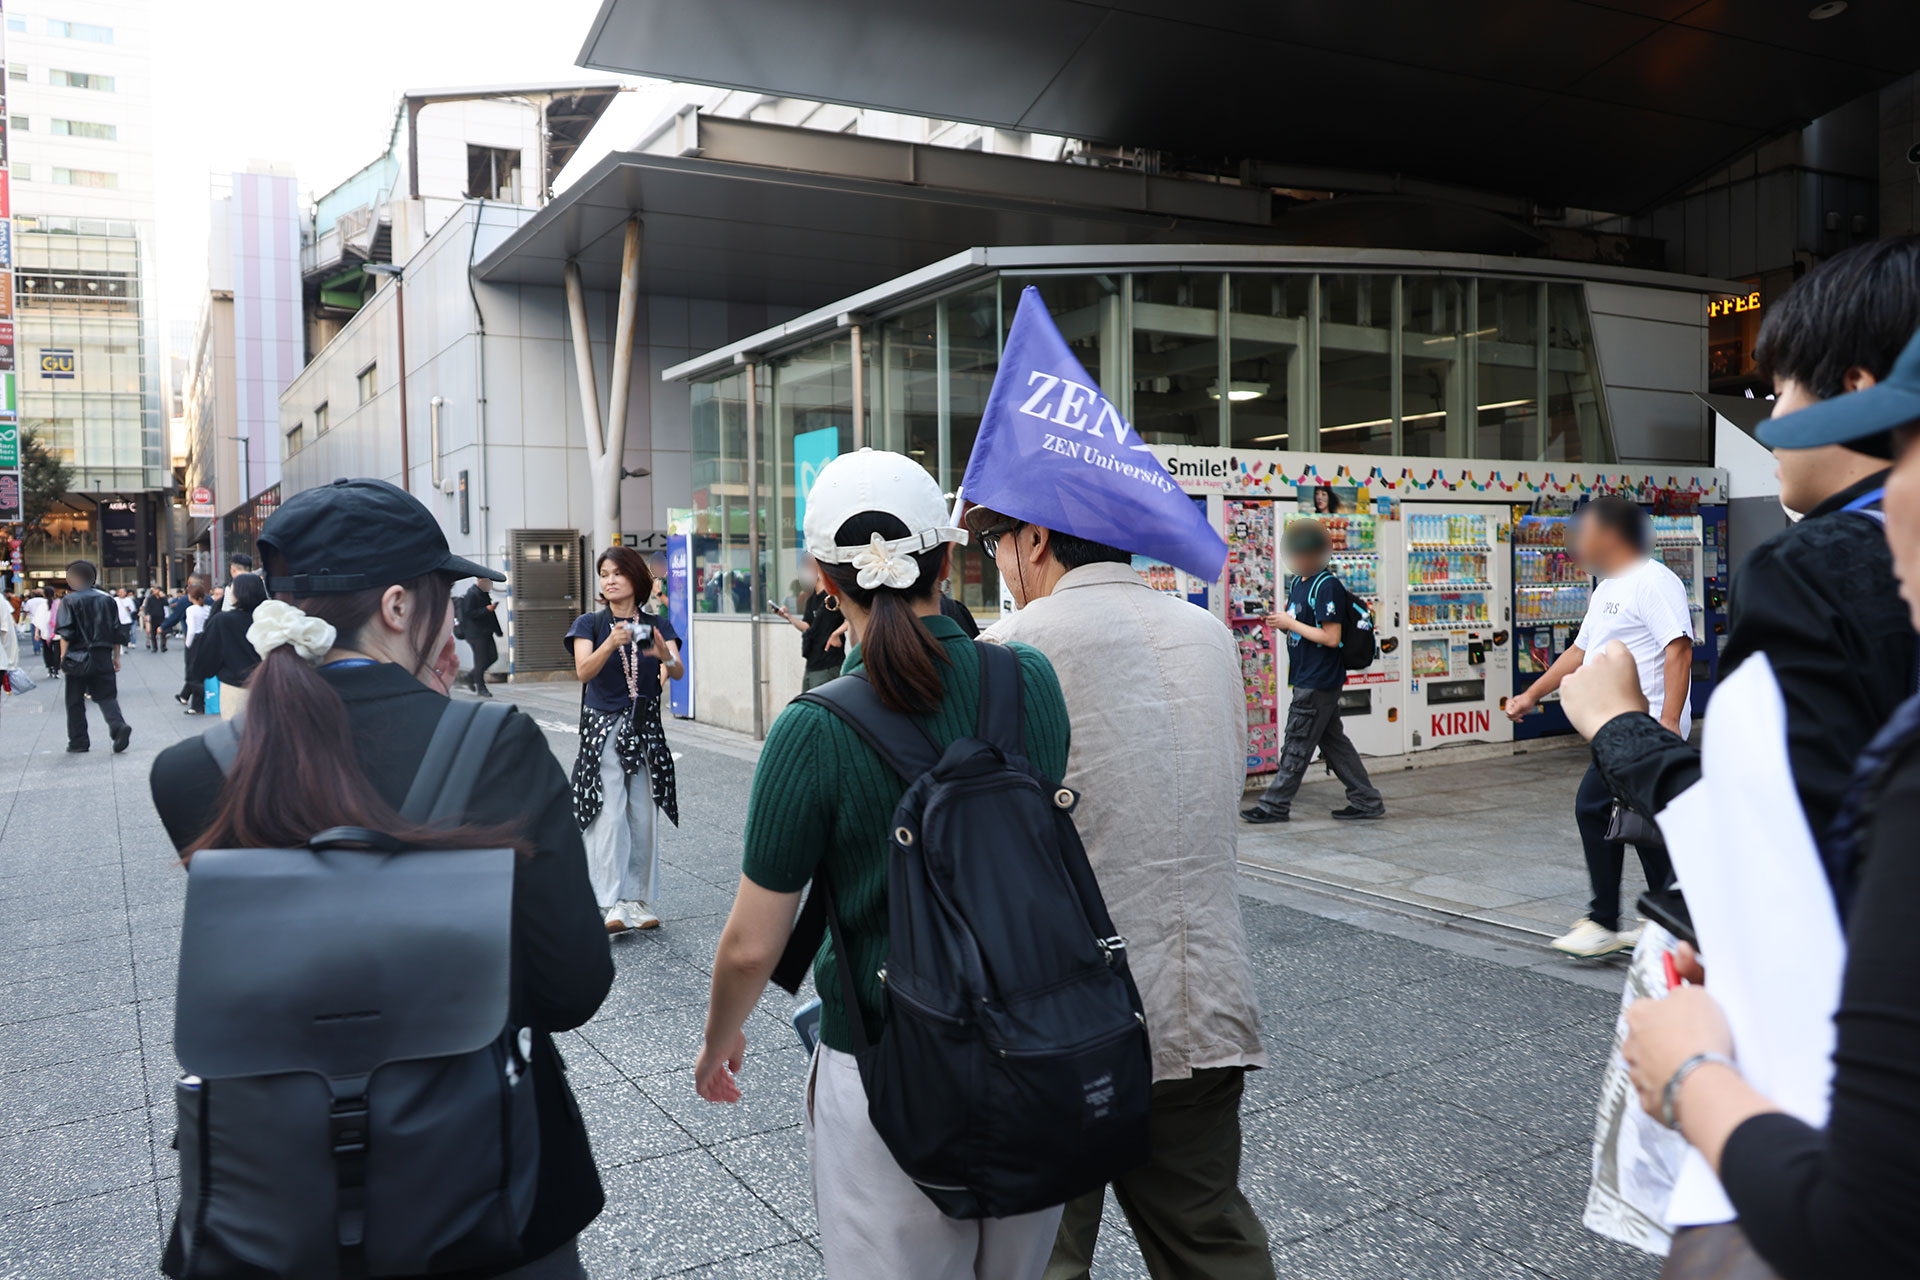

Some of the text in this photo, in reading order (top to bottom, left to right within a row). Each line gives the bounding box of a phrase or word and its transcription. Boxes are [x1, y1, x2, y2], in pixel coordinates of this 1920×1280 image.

[42, 357, 73, 371] GU
[1019, 370, 1131, 445] ZEN
[1042, 433, 1176, 494] ZEN University
[1167, 457, 1227, 477] Smile!
[1431, 709, 1490, 737] KIRIN
